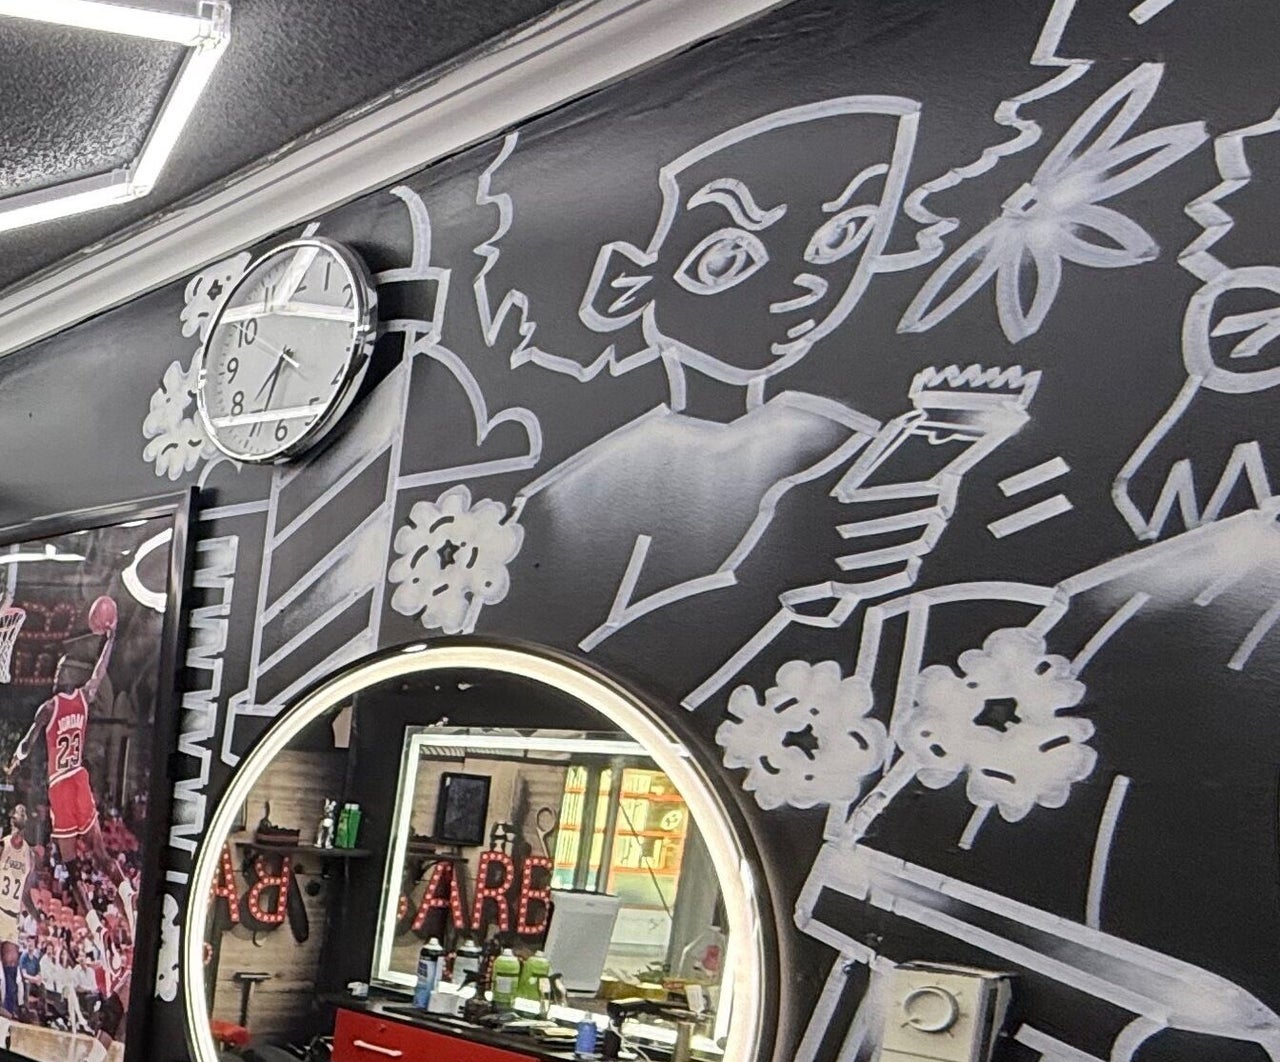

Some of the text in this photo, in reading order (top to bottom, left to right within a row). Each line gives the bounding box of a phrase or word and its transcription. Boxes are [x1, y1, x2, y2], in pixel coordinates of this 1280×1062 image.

[237, 317, 258, 349] 10
[227, 356, 239, 384] 9
[230, 390, 244, 417] 8
[275, 418, 288, 442] 6
[55, 730, 82, 772] 23
[1, 876, 22, 901] 32
[398, 850, 554, 935] ARB
